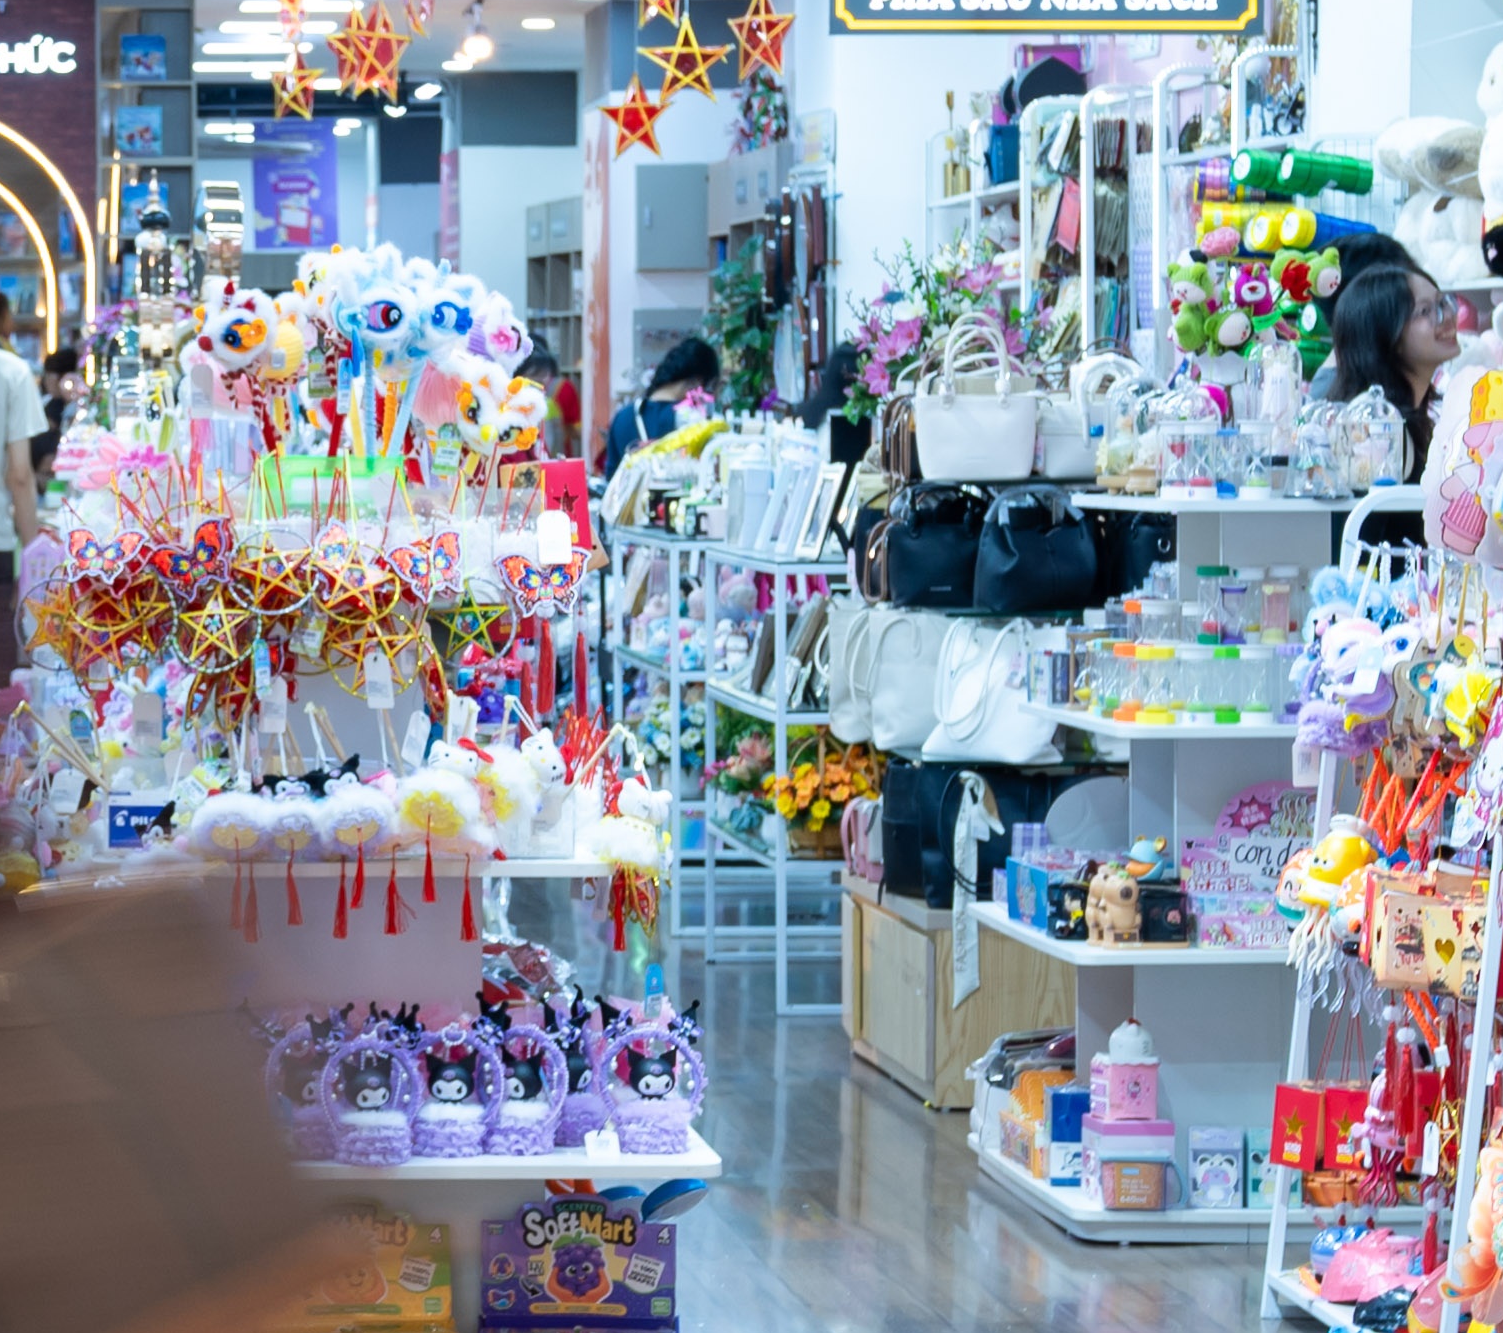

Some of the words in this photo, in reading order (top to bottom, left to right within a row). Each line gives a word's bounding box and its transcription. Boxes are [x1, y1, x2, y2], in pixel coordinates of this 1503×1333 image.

[1235, 842, 1272, 865] con
[555, 1202, 604, 1213] SCENTED
[523, 1210, 635, 1247] SoftMart
[657, 1225, 671, 1239] 4
